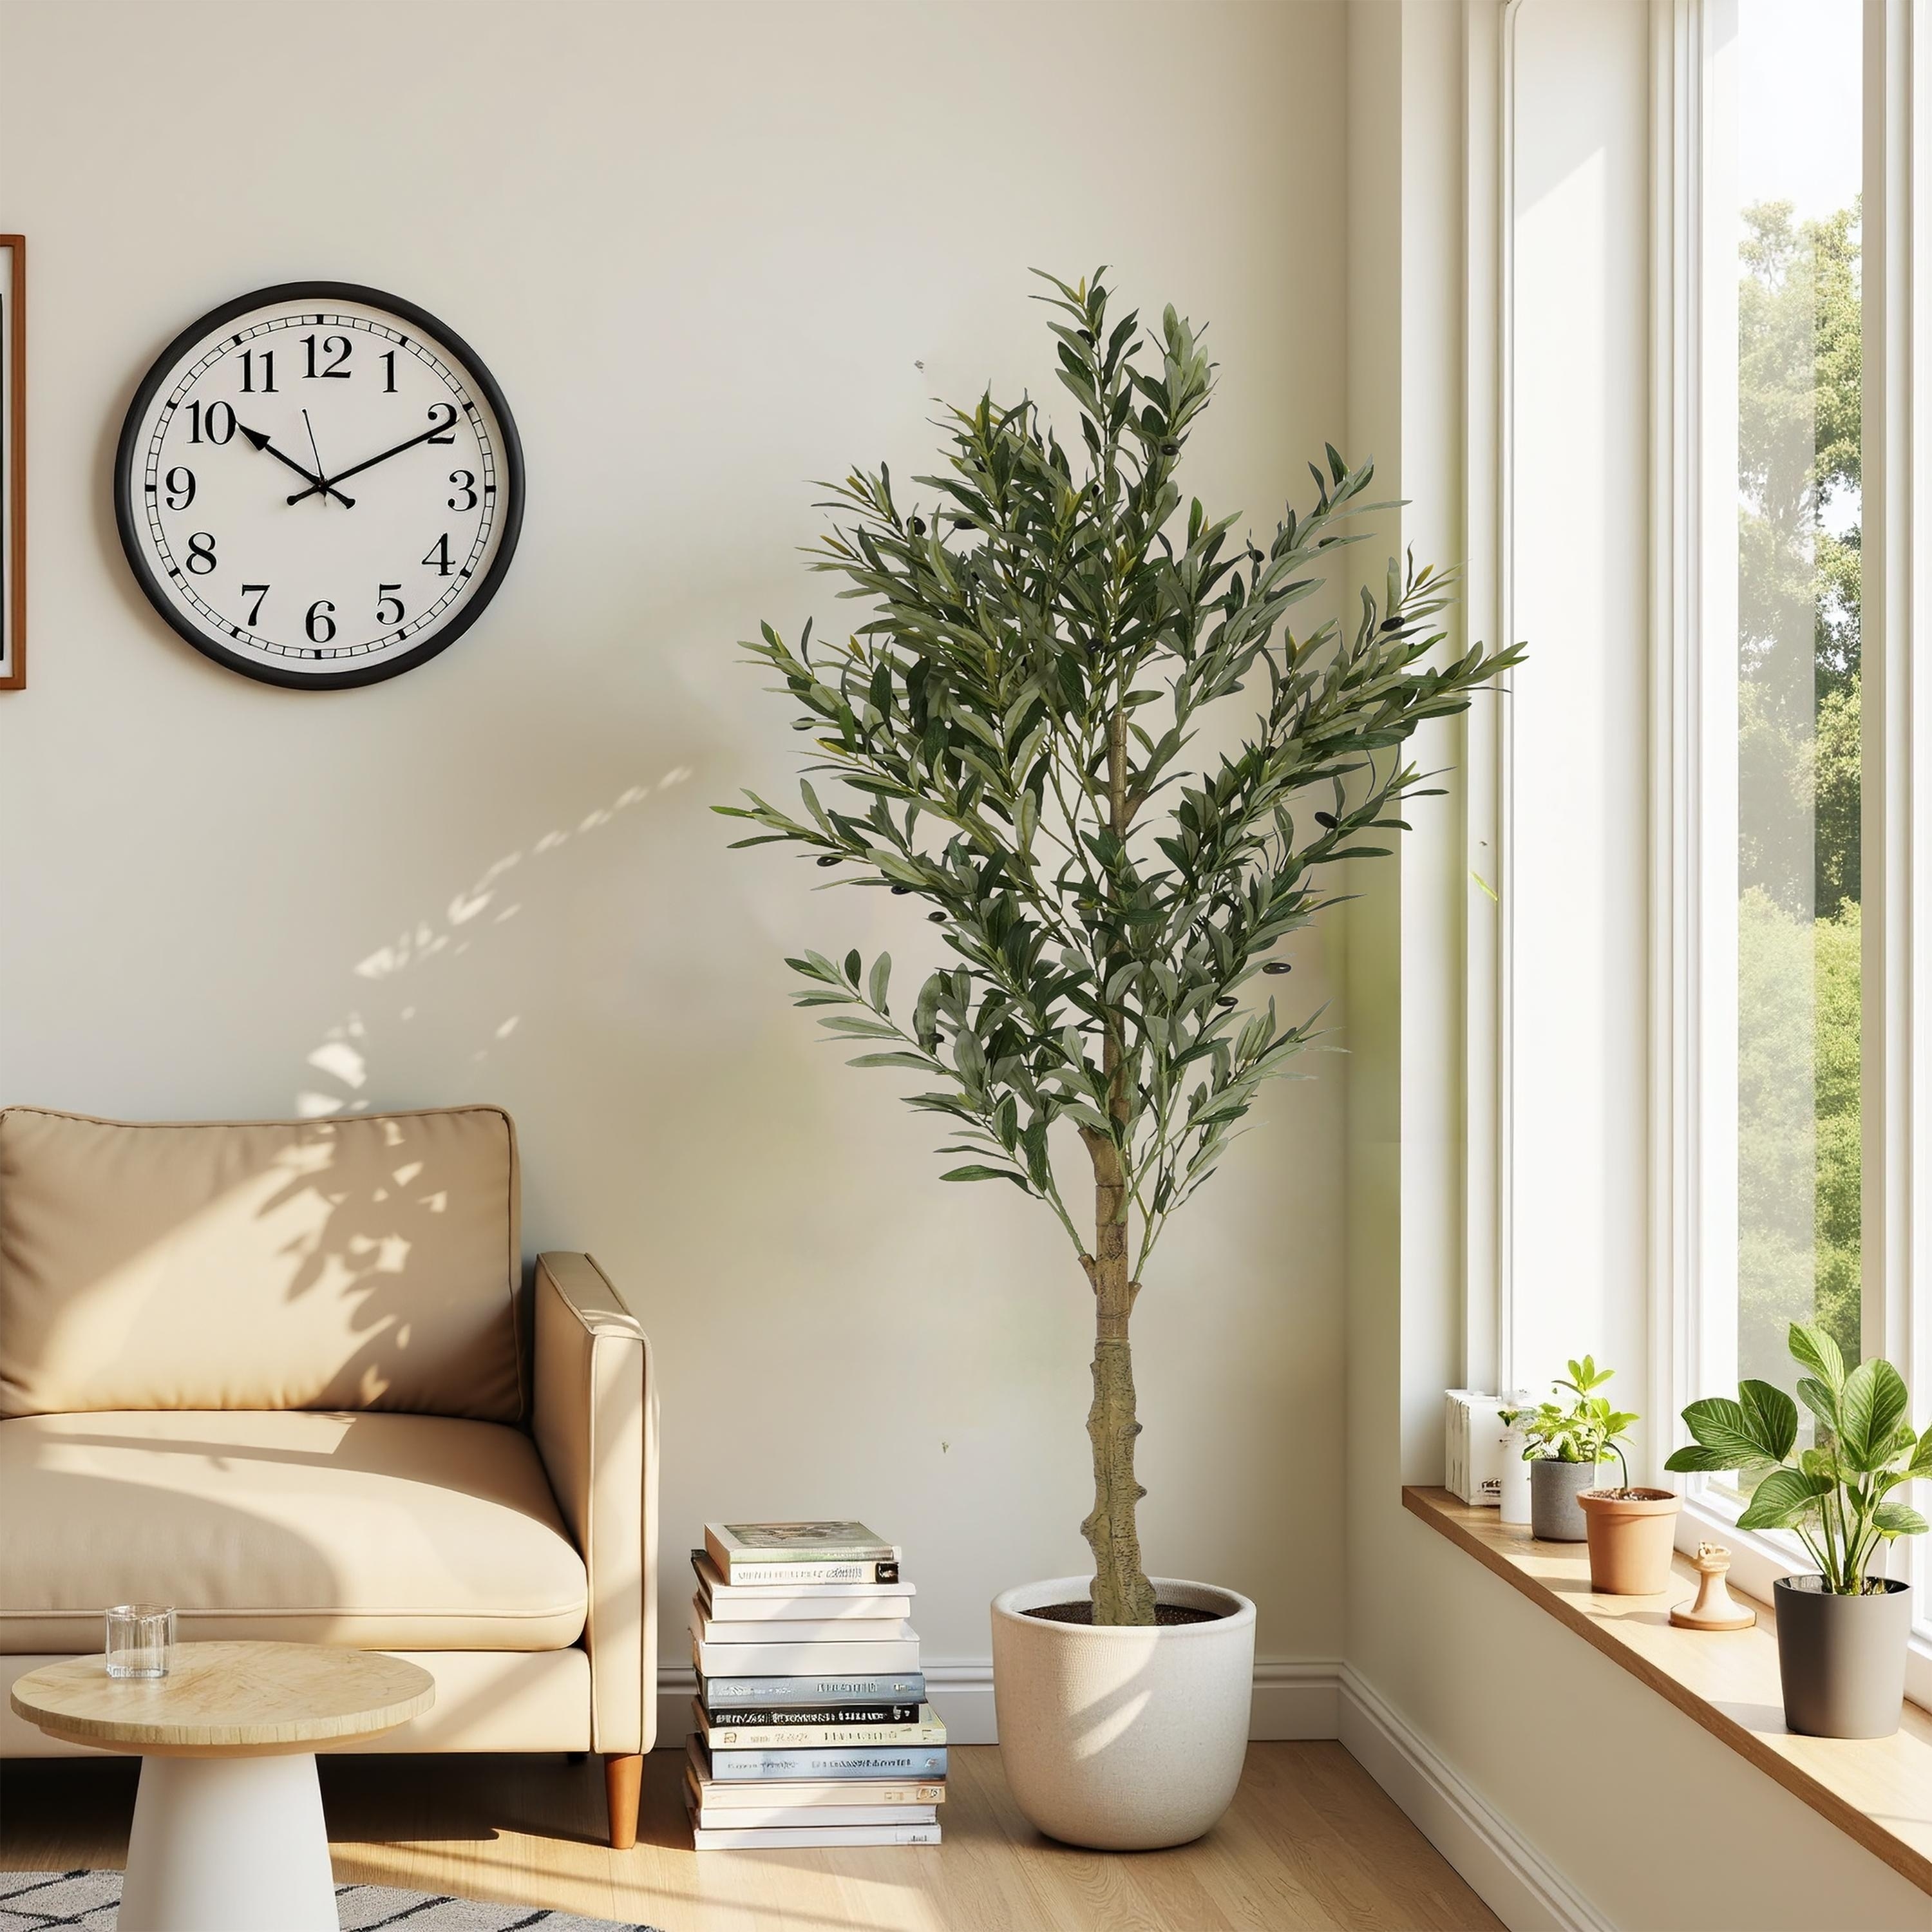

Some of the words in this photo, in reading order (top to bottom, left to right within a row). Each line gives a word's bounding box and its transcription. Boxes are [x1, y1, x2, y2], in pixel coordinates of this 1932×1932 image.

[237, 349, 279, 392] 11
[300, 334, 352, 378] 12
[379, 350, 397, 393] 1
[185, 400, 236, 445] 10
[427, 403, 458, 444] 2
[166, 467, 195, 510] 9
[448, 470, 477, 511] 3
[186, 533, 216, 574] 8
[422, 533, 455, 576] 4
[242, 585, 270, 626] 7
[306, 600, 336, 643] 6
[377, 584, 404, 625] 5
